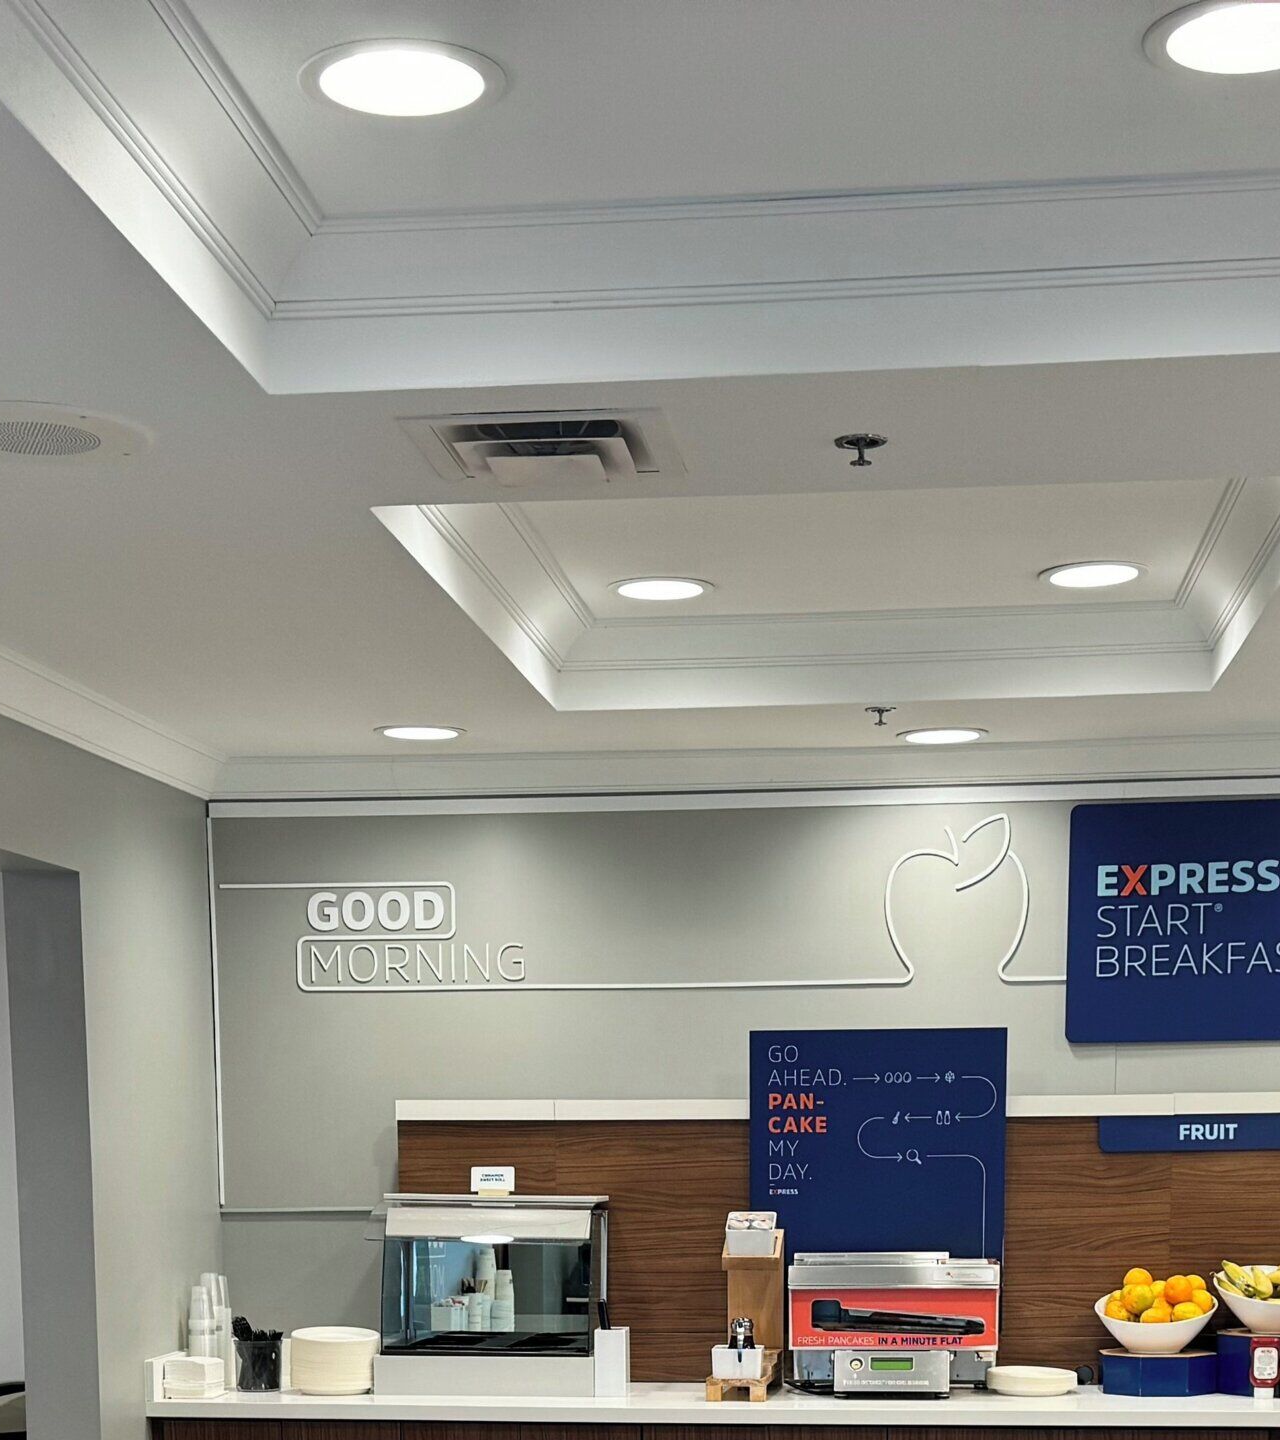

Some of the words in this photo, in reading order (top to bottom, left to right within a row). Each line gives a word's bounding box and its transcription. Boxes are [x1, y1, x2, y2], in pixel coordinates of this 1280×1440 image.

[1096, 858, 1280, 897] EXPRESS
[306, 890, 445, 931] GOOD
[309, 941, 526, 983] MORNING
[768, 1045, 799, 1063] GO
[767, 1068, 847, 1087] AHEAD.
[768, 1093, 825, 1110] PAN-
[768, 1116, 828, 1134] CAKE
[1178, 1123, 1239, 1141] FRUIT
[769, 1140, 800, 1157] MY
[768, 1163, 813, 1181] DAY.
[797, 1337, 825, 1345] FRESH
[828, 1336, 874, 1345] PANCAKES
[877, 1336, 888, 1345] IN
[891, 1336, 898, 1345] A
[900, 1336, 937, 1346] MINUTE
[940, 1336, 964, 1345] FLAT
